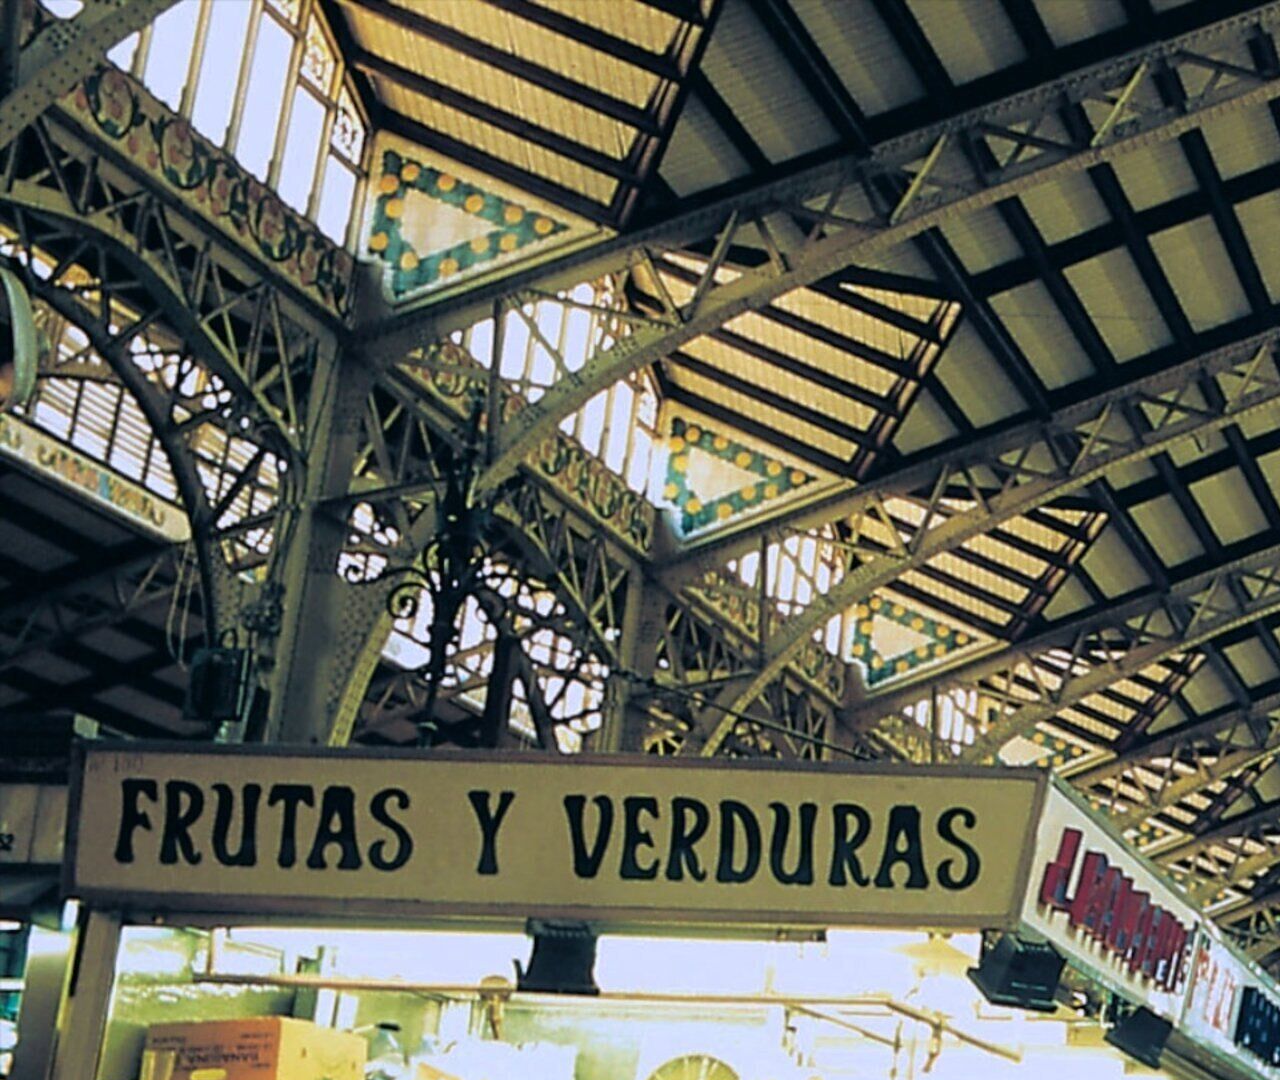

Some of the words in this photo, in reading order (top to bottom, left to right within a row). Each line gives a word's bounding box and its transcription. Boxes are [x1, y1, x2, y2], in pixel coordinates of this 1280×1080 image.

[114, 777, 415, 872] FRUTAS
[467, 790, 516, 876] Y
[563, 793, 981, 891] VERDURAS
